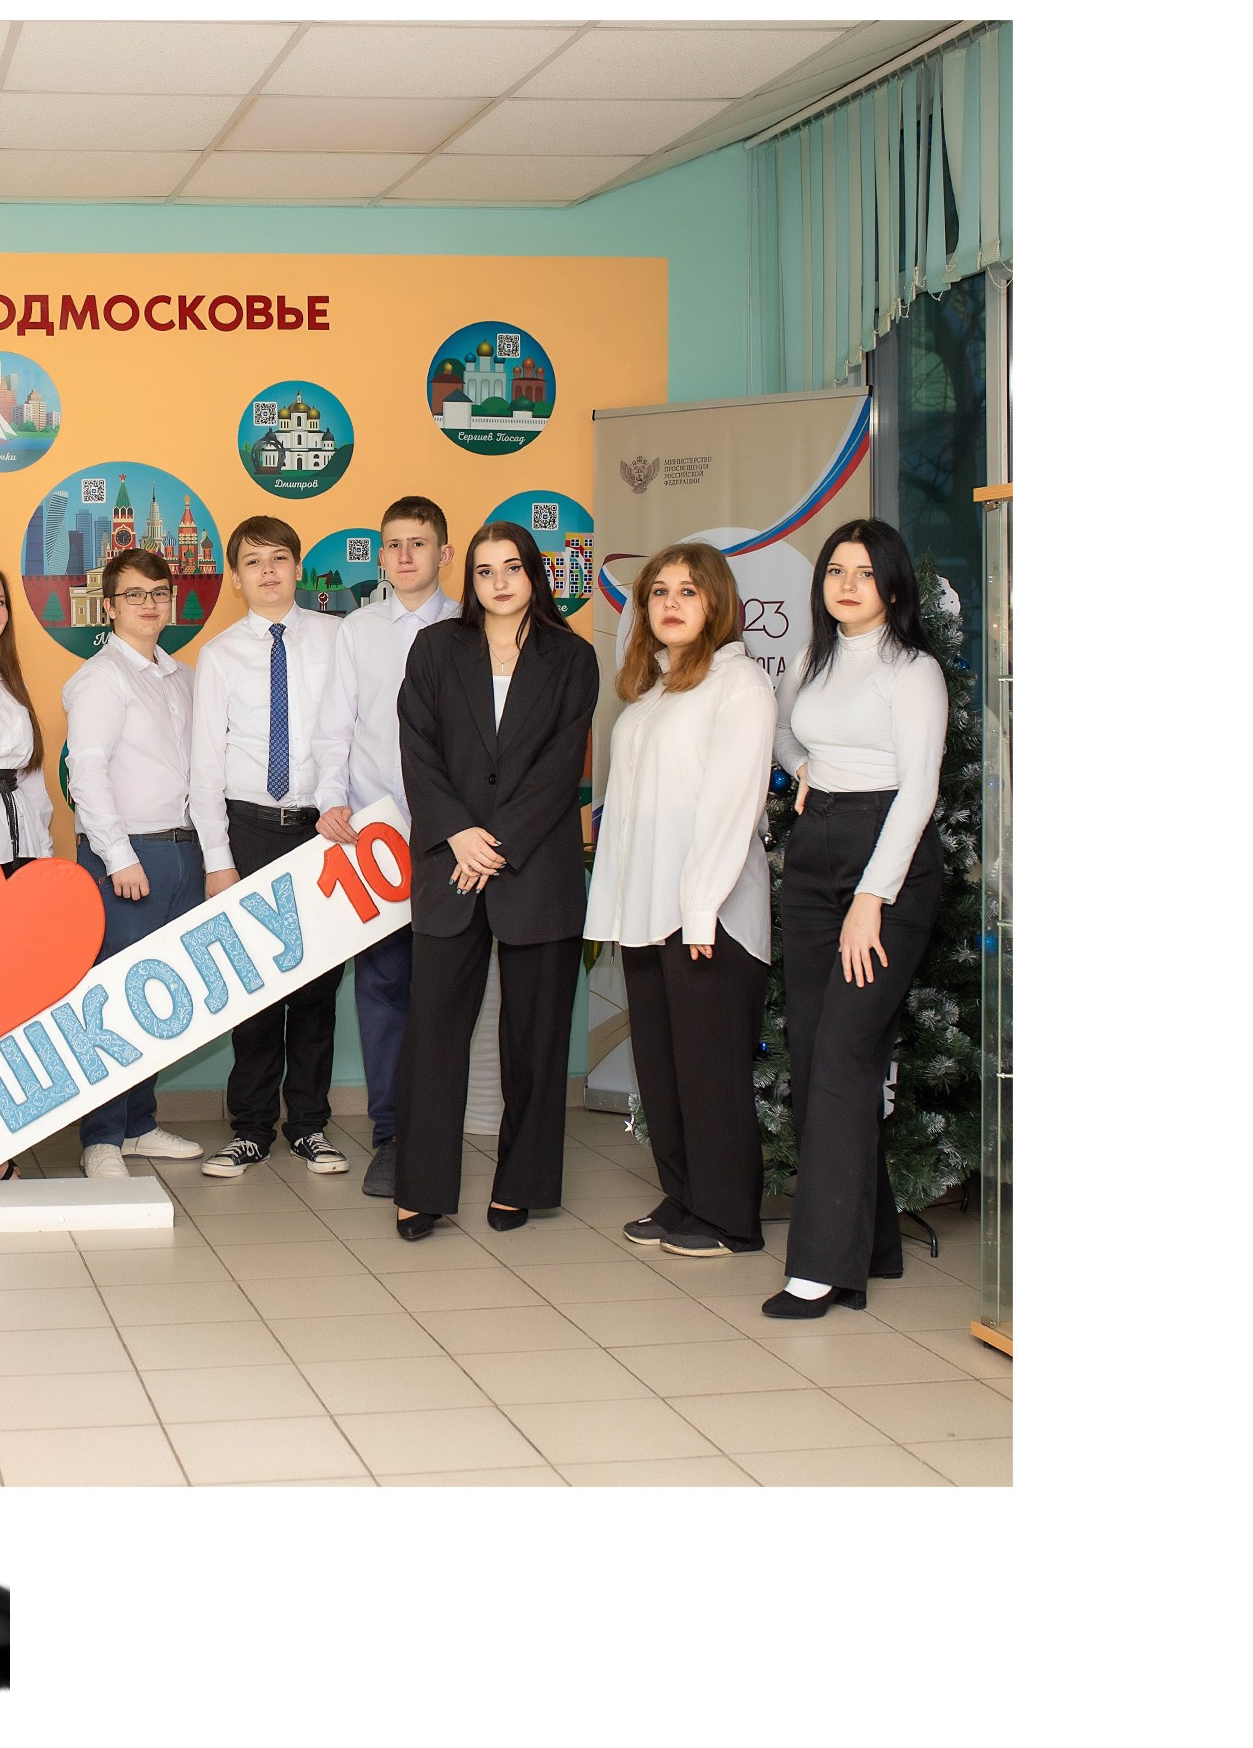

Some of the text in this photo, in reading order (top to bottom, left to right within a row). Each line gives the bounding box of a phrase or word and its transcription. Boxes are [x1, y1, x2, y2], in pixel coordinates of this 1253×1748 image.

[458, 431, 526, 445] Сергиев Посад
[274, 478, 319, 491] Дмитров
[742, 598, 789, 639] 23
[317, 821, 412, 924] 10
